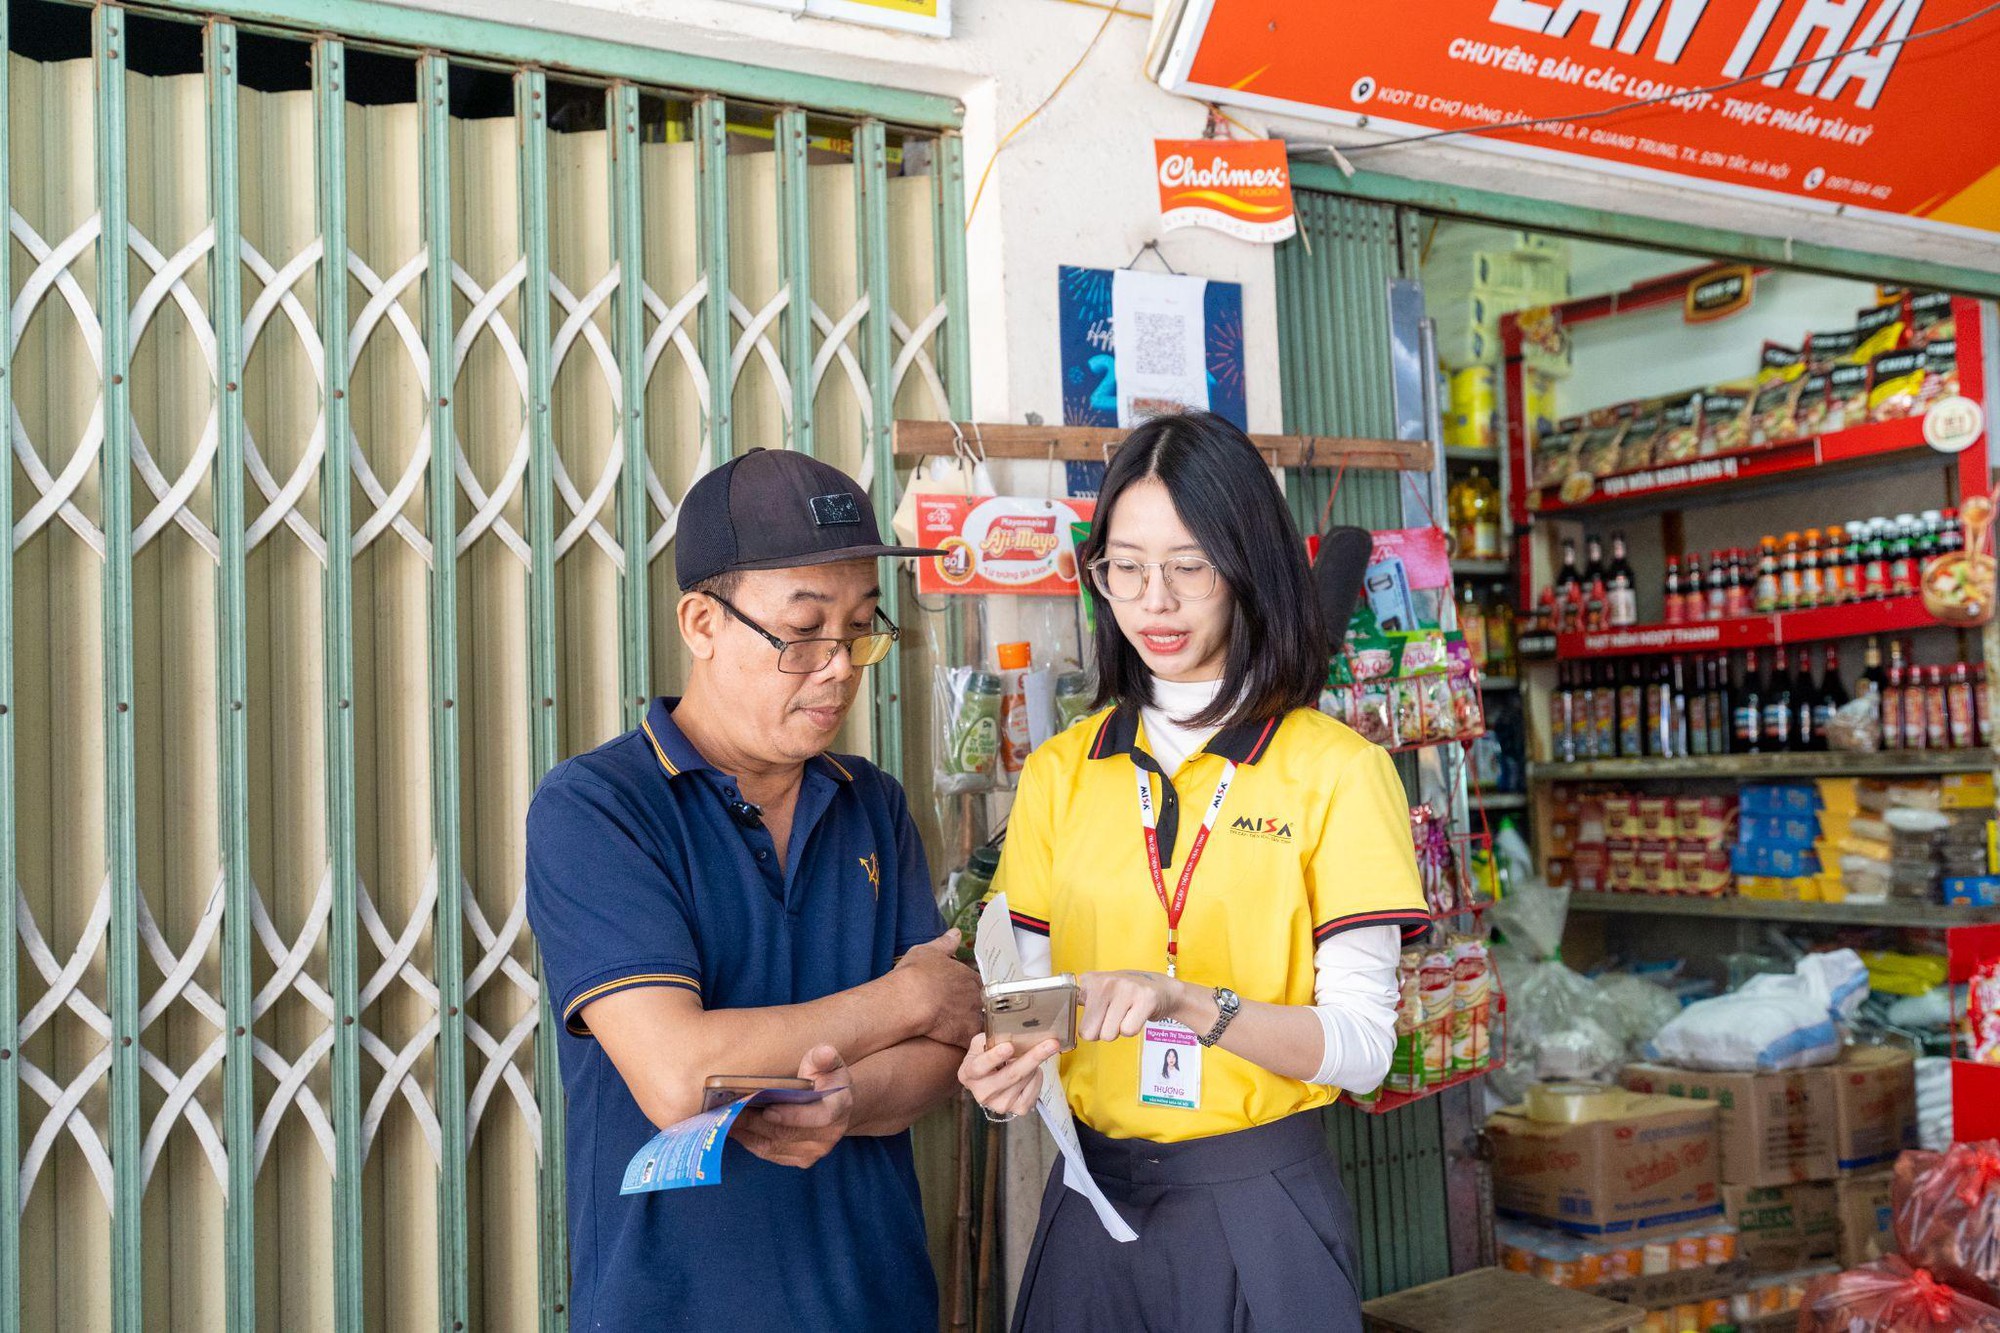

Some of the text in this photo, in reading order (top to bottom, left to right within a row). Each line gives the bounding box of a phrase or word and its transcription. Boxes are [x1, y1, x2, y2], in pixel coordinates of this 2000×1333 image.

[1448, 37, 1538, 75] CHUYÊN:
[1537, 56, 1585, 85] BÁN
[1583, 66, 1626, 94] CÁC
[1721, 97, 1772, 126] THỰC
[1378, 86, 1414, 105] KIOT
[1413, 93, 1429, 109] 13
[1429, 97, 1463, 117] CHỢ
[1461, 102, 1504, 124] NÔNG
[1160, 154, 1285, 188] Cholimex
[1140, 786, 1150, 810] MISA
[1213, 782, 1228, 808] MISA
[1232, 816, 1292, 837] MISA
[1154, 1085, 1185, 1096] THƯƠNG
